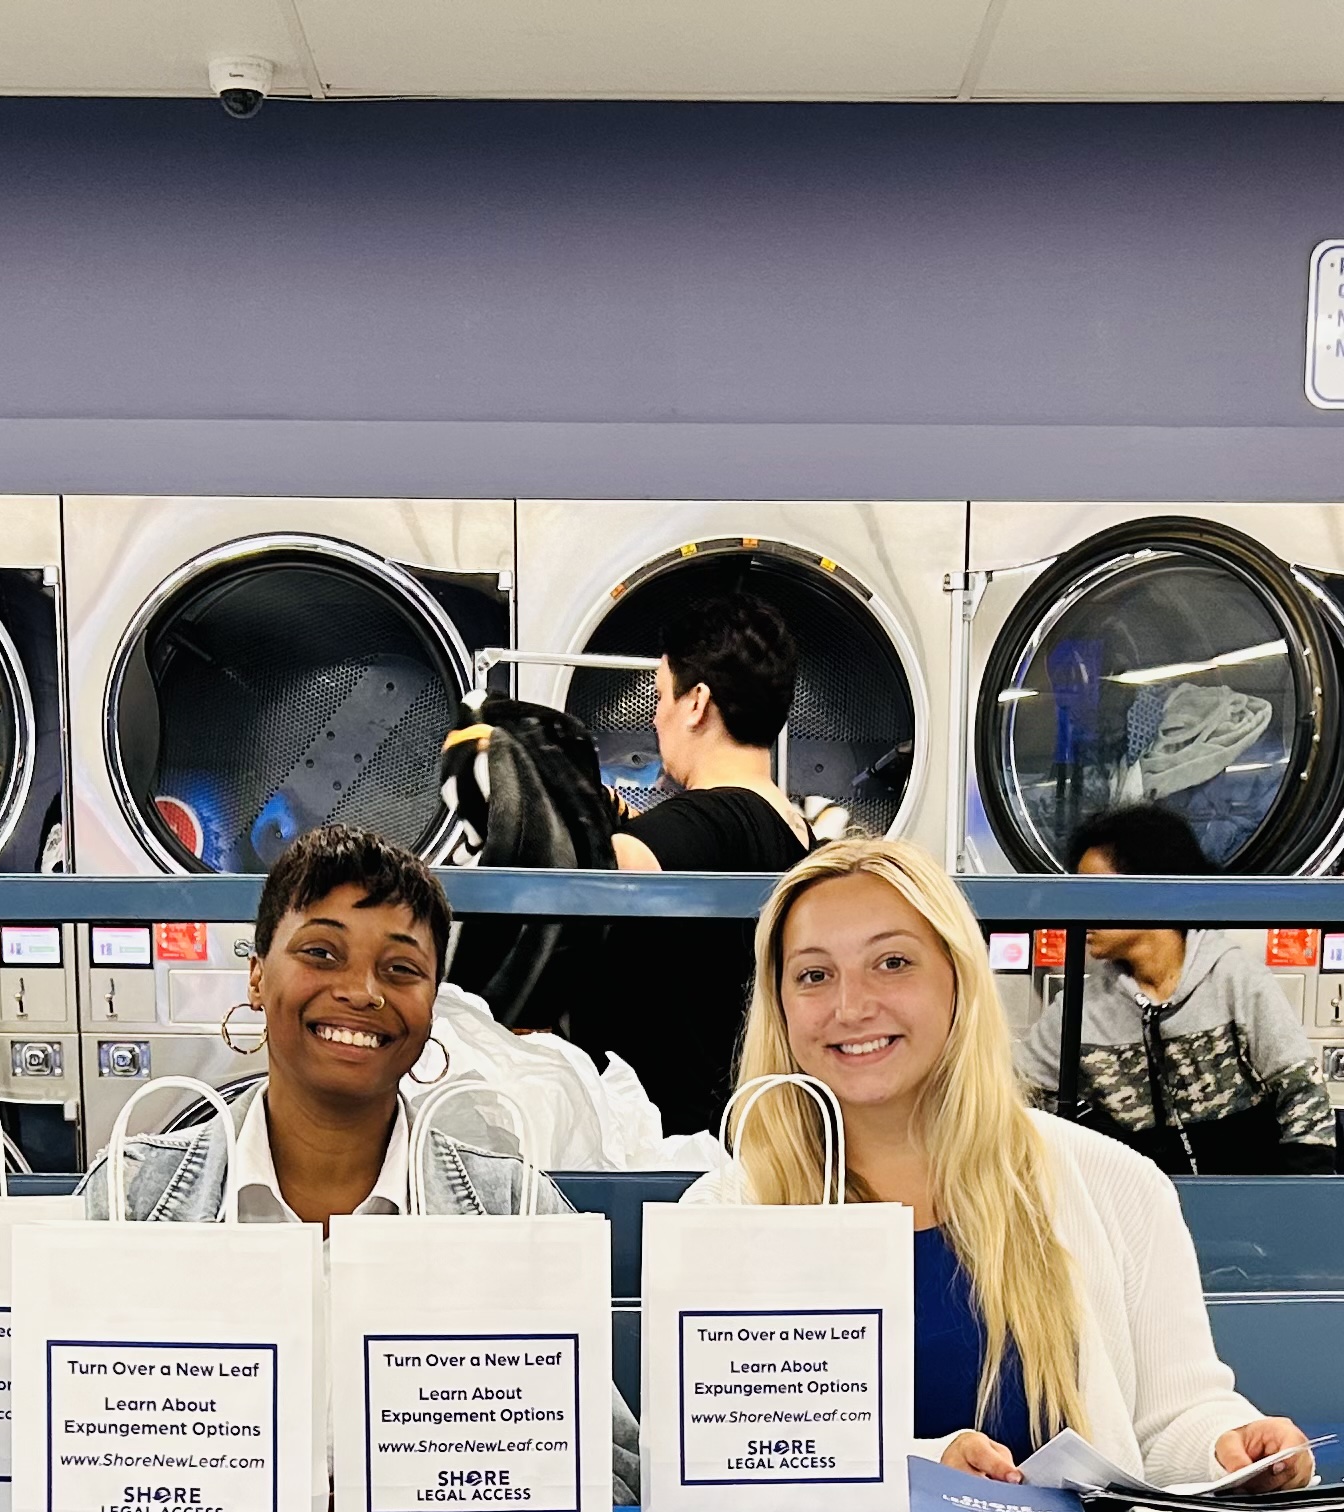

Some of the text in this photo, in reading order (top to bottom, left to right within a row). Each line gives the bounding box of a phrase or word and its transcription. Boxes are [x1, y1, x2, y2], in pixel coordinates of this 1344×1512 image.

[697, 1326, 867, 1341] Turn Over a New Leaf
[383, 1352, 562, 1367] Turn Over a New Leaf
[731, 1360, 828, 1373] Learn About
[67, 1360, 260, 1377] Turn Over a New Leaf
[419, 1387, 522, 1400] Learn About
[694, 1380, 868, 1397] Expungement Options
[105, 1397, 217, 1412] Learn About
[382, 1407, 564, 1425] Expungement Options
[691, 1409, 871, 1423] www.ShoreNewLeaf.com
[64, 1420, 261, 1438] Expungement Options
[378, 1439, 568, 1453] www.ShoreNewLeaf.com
[748, 1440, 816, 1455] SHORE
[60, 1453, 265, 1469] www.ShoreNewLeaf.com
[728, 1457, 836, 1469] LEGAL ACCESS
[438, 1470, 510, 1487] SHORE
[124, 1487, 201, 1503] SHORE
[417, 1488, 531, 1501] LEGAL ACCESS
